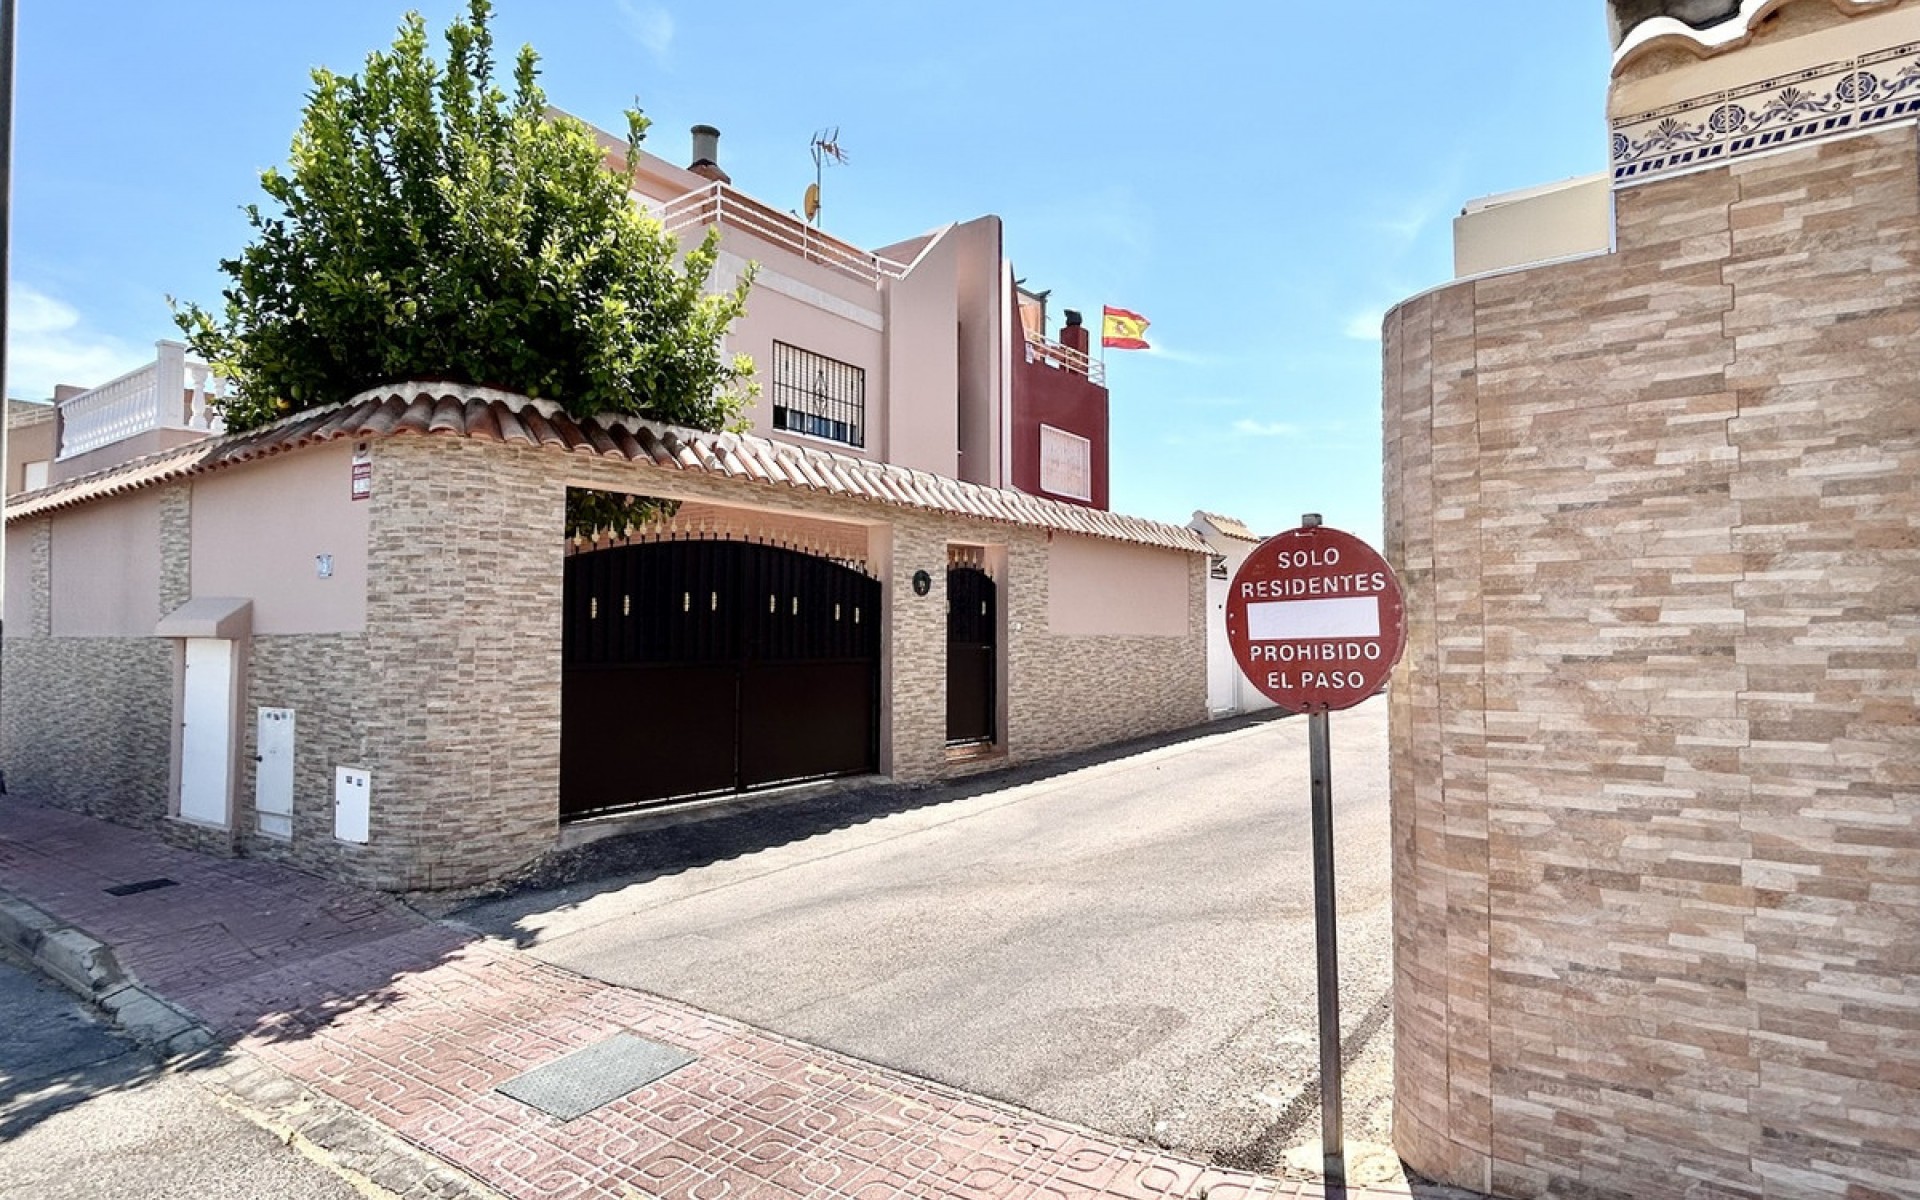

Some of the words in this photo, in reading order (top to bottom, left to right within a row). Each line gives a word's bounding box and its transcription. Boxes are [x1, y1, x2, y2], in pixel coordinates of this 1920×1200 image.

[1278, 548, 1340, 569] SOLO
[1241, 572, 1386, 598] RESIDENTES
[1250, 642, 1381, 662] PROHIBIDO
[1267, 671, 1293, 689] EL
[1301, 671, 1364, 689] PASO
